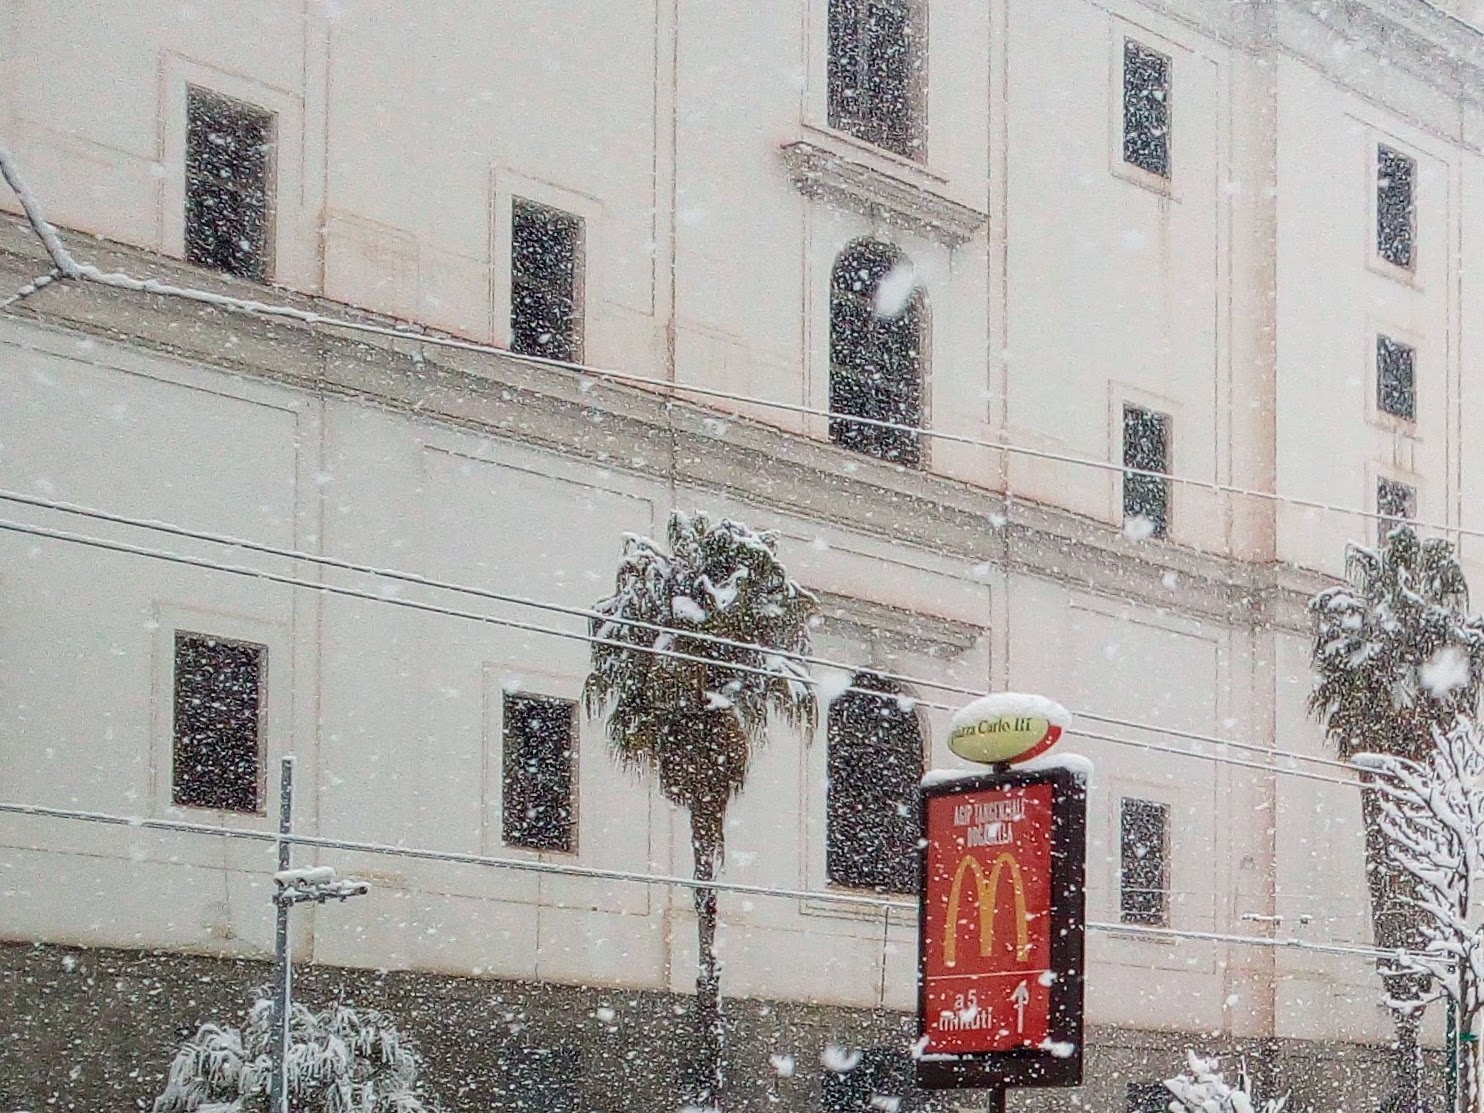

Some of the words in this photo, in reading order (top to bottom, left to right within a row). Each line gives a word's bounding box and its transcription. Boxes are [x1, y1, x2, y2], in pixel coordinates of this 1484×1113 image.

[978, 718, 1011, 734] Carlo
[954, 994, 964, 1009] a
[968, 989, 977, 1007] 5
